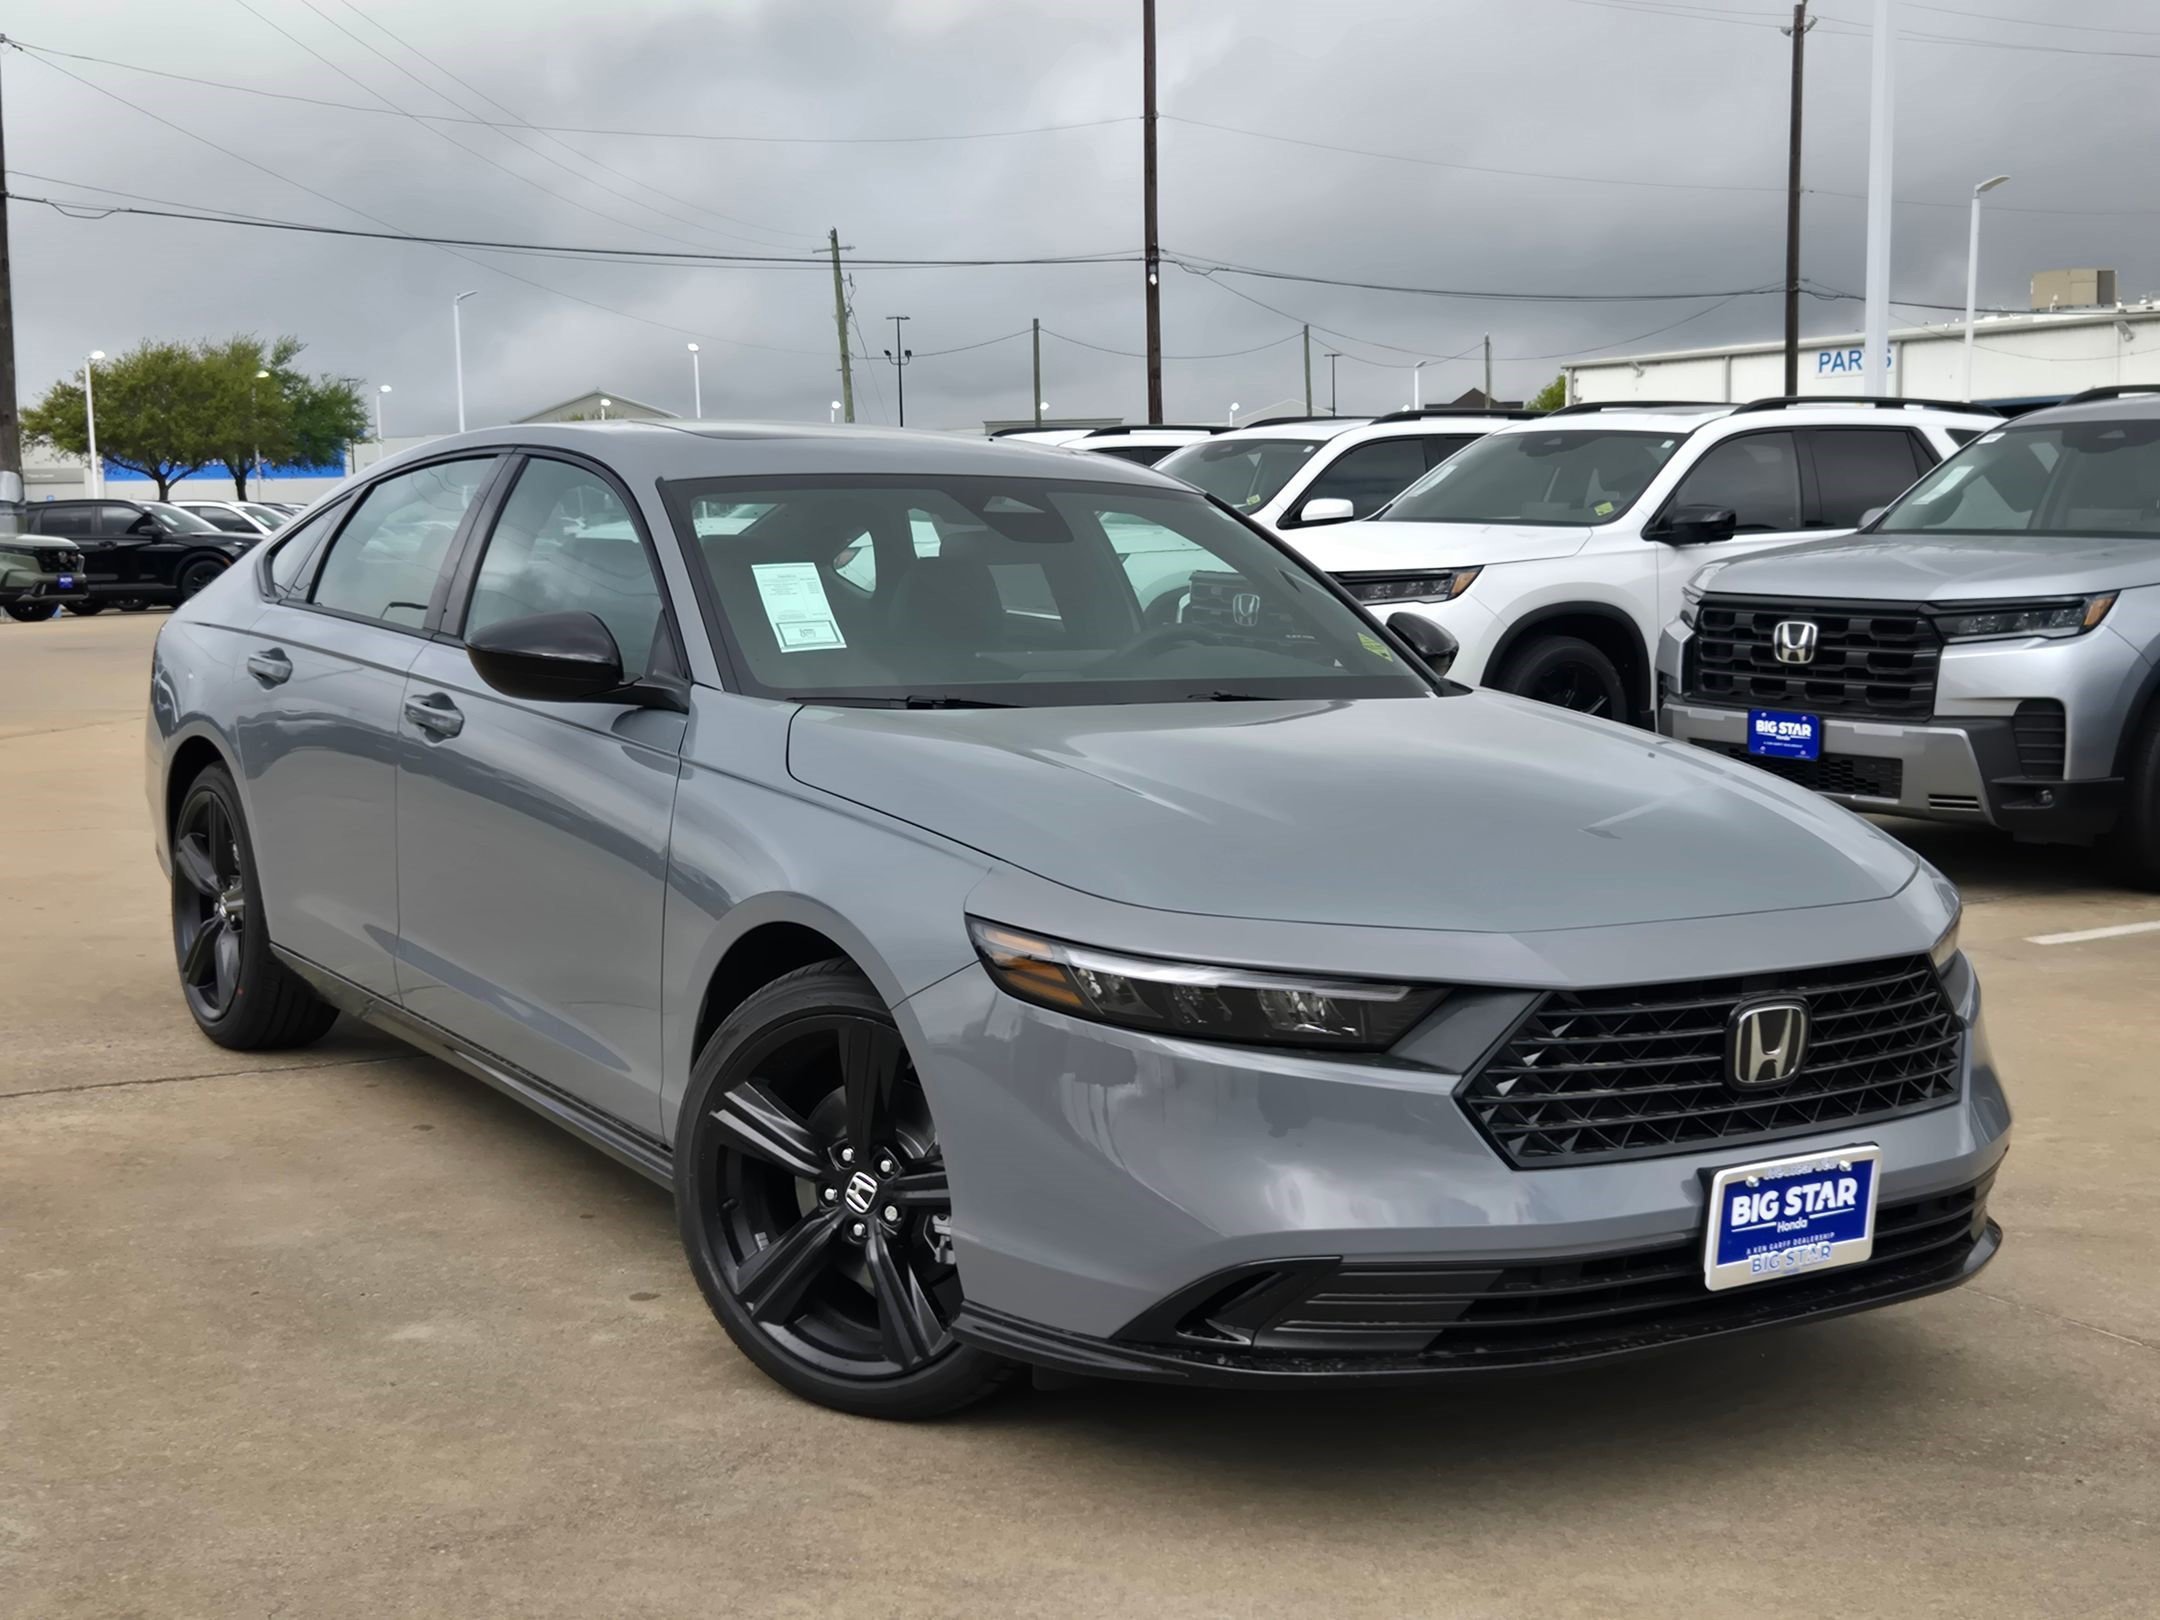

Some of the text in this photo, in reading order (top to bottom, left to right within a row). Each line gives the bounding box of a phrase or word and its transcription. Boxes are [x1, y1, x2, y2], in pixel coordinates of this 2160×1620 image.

[1818, 347, 1892, 374] PAR
[1755, 720, 1812, 737] BIG STAR
[1731, 1178, 1858, 1226] BIG STAR
[1777, 1218, 1808, 1233] Honda
[1792, 1232, 1835, 1246] DEALERSHIP
[1751, 1244, 1832, 1273] BIG STAR
